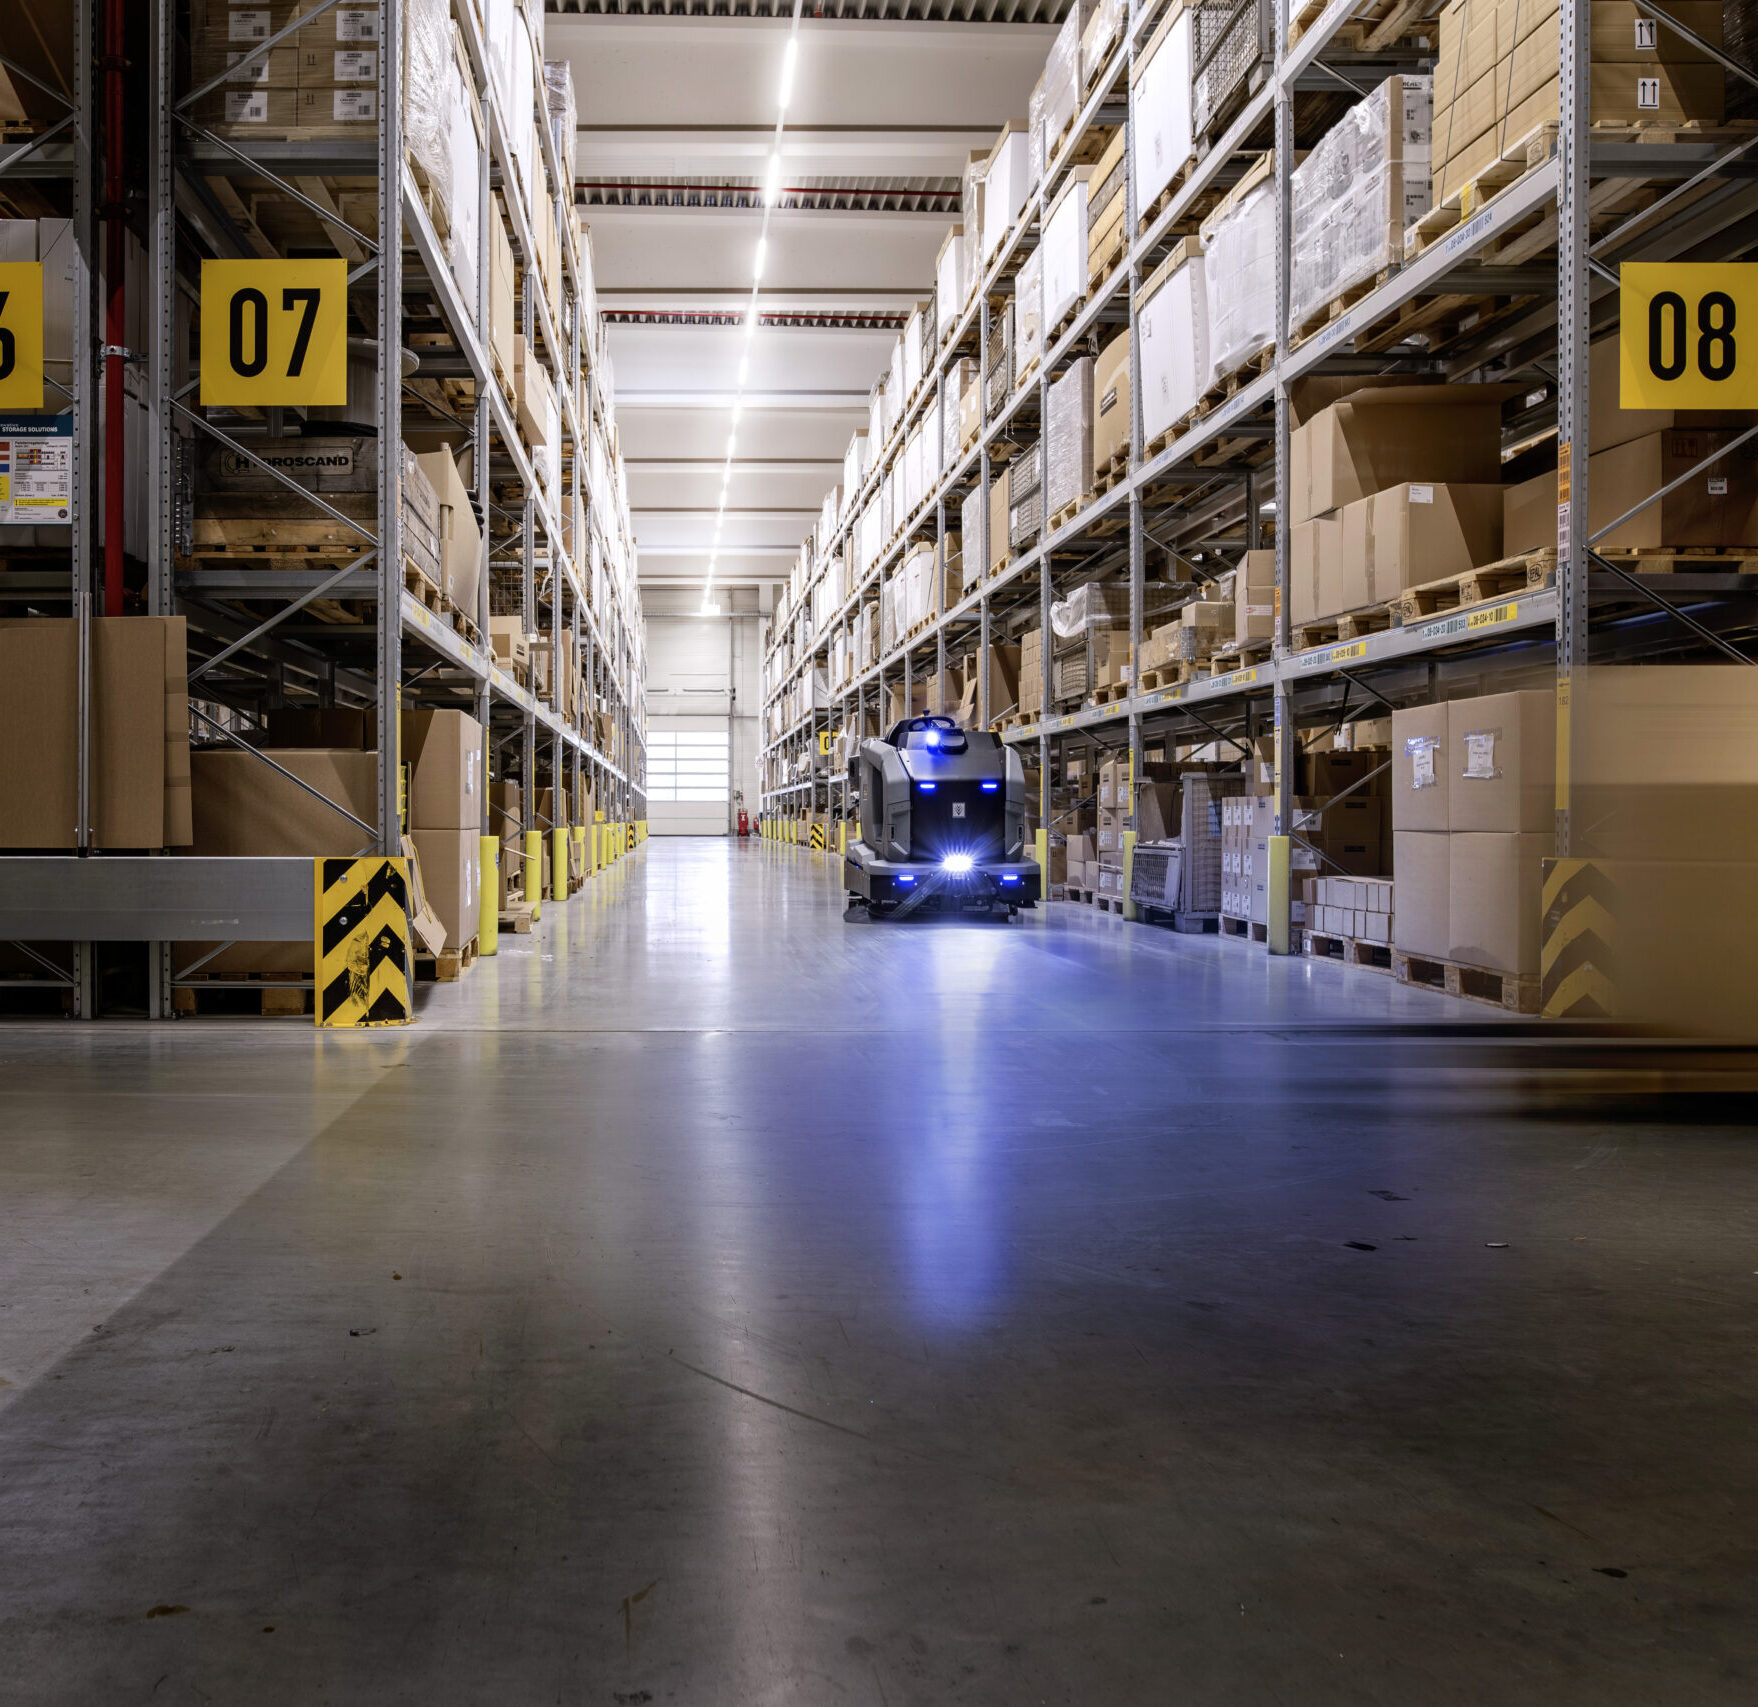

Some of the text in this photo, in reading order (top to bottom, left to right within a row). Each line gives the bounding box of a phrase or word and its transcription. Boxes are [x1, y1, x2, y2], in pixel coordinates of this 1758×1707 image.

[229, 287, 321, 377] 07
[1648, 290, 1736, 381] 08
[235, 456, 349, 469] HDROSCAND
